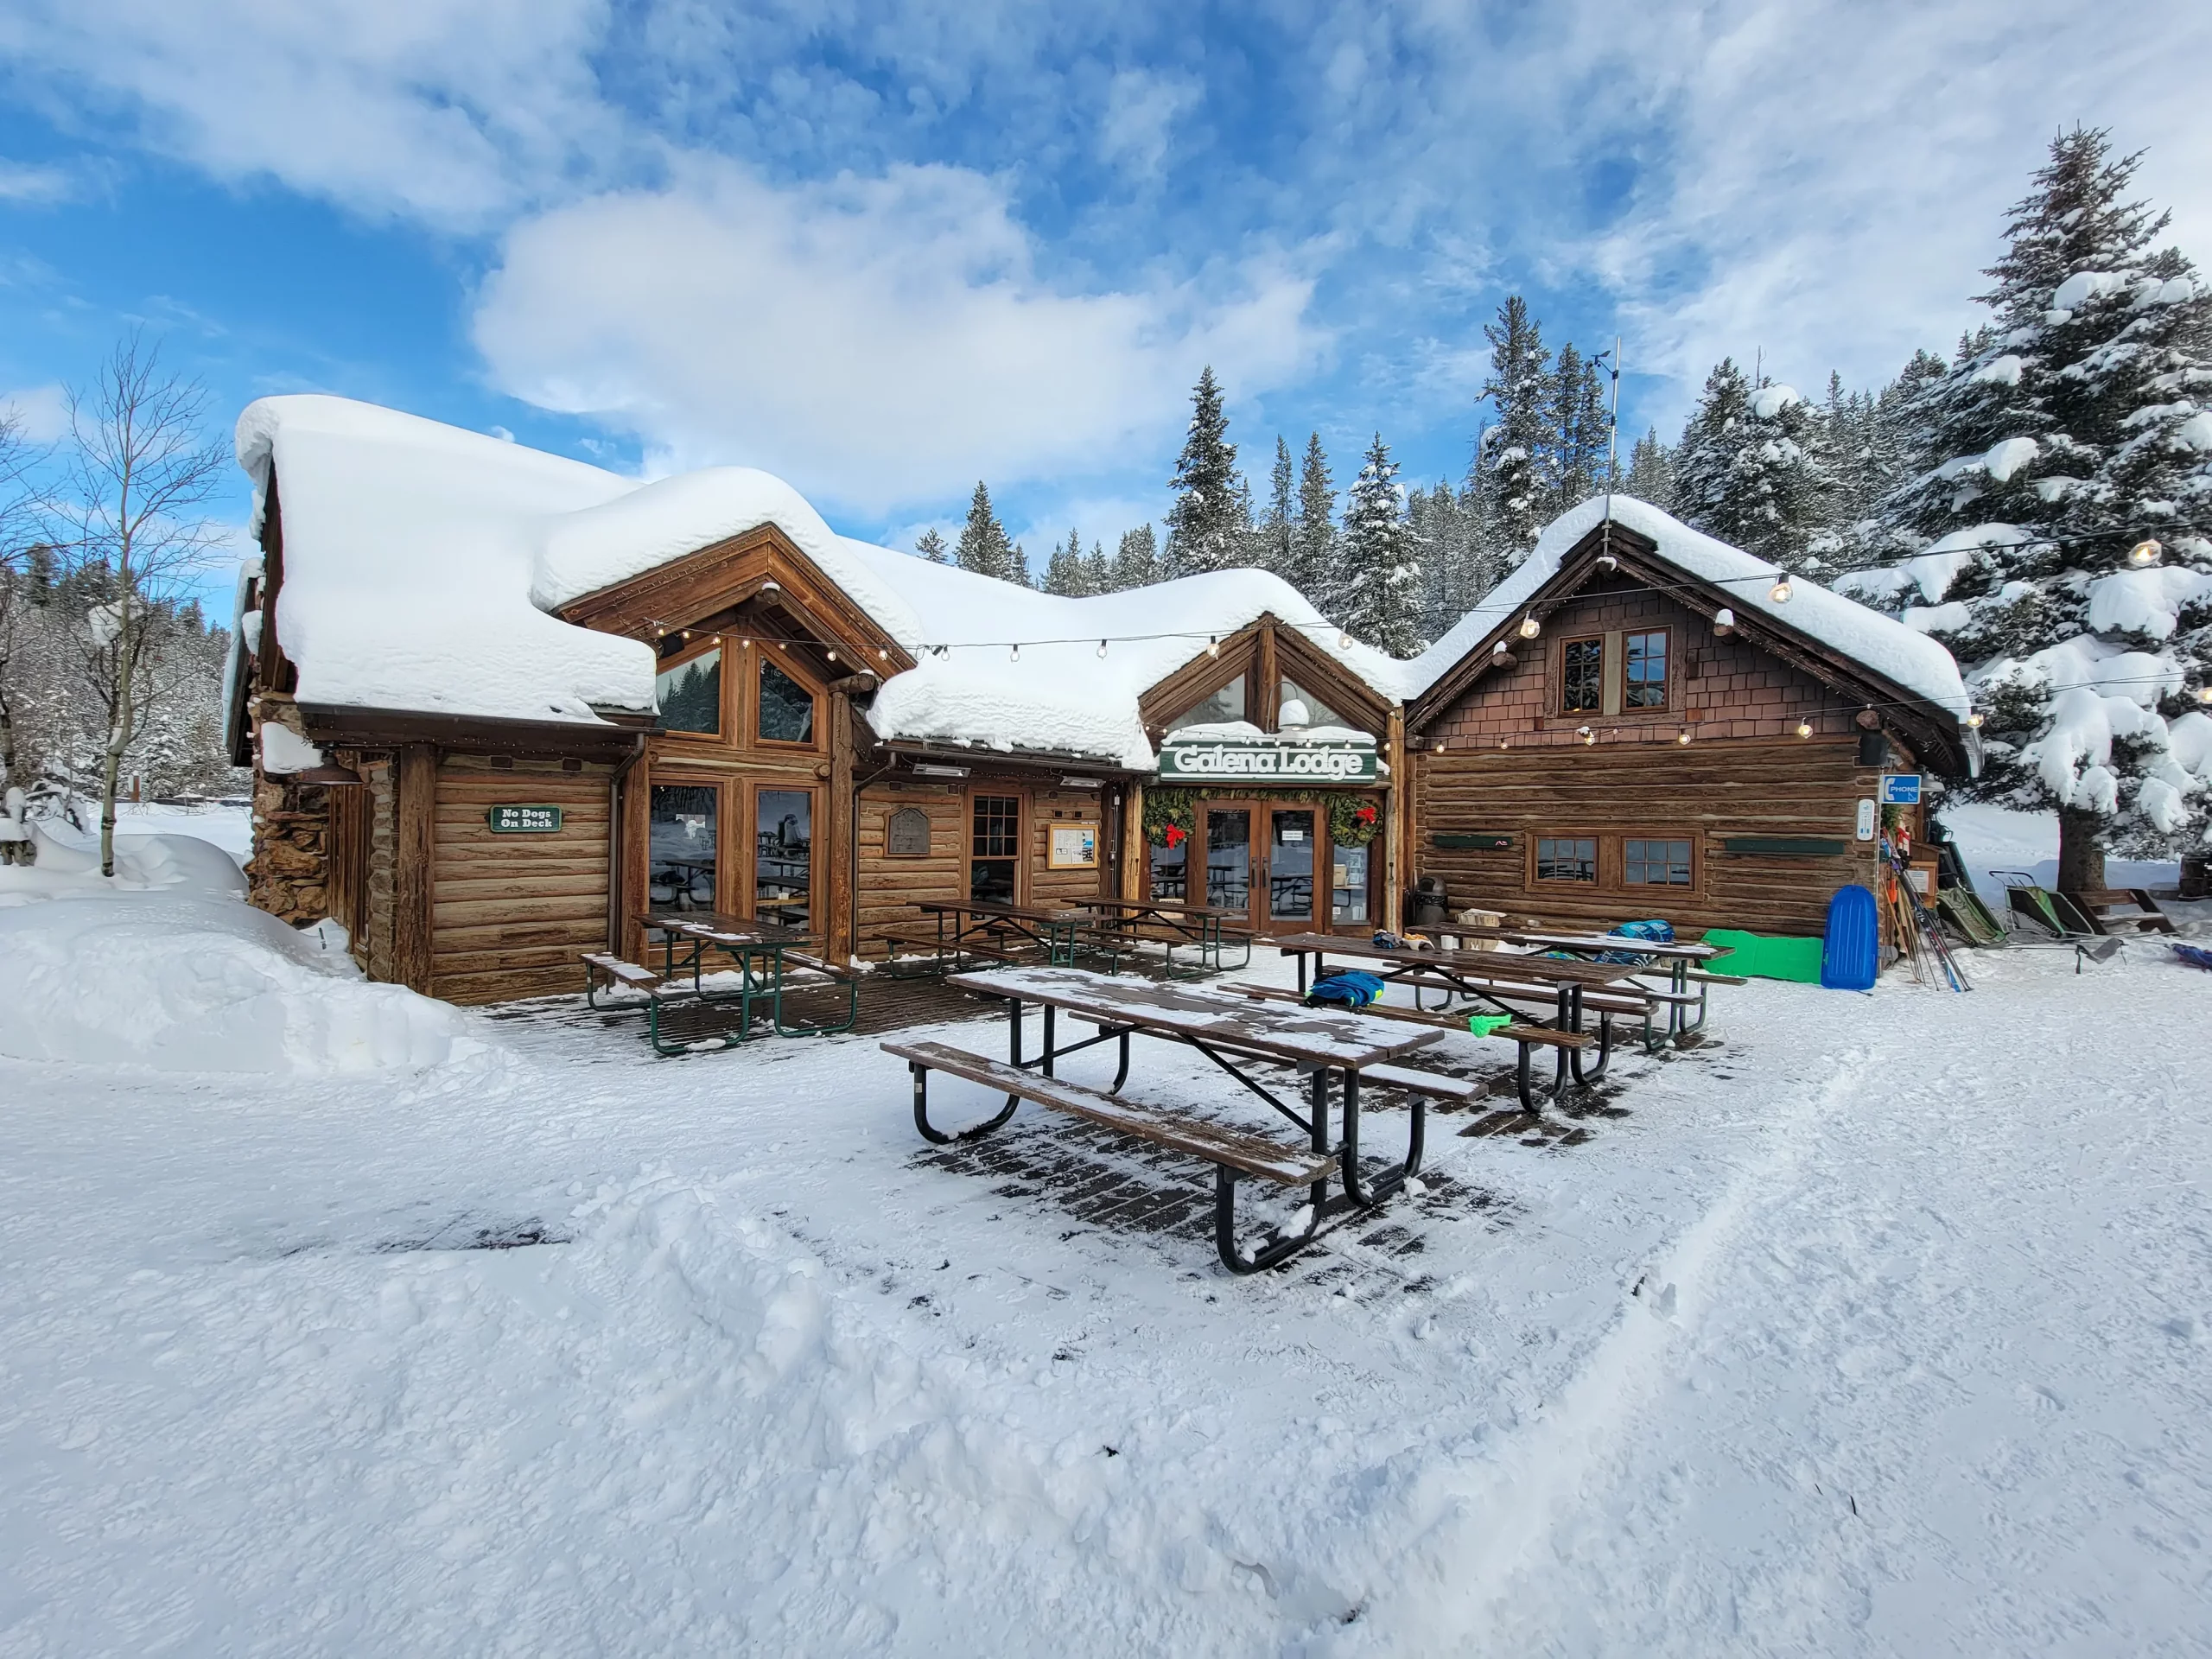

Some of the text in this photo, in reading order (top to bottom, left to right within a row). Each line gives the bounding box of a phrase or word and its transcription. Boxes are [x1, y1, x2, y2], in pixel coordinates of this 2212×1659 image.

[1173, 744, 1363, 781] Galena Lodge
[502, 809, 551, 819] No Dogs
[501, 818, 552, 827] On Deck
